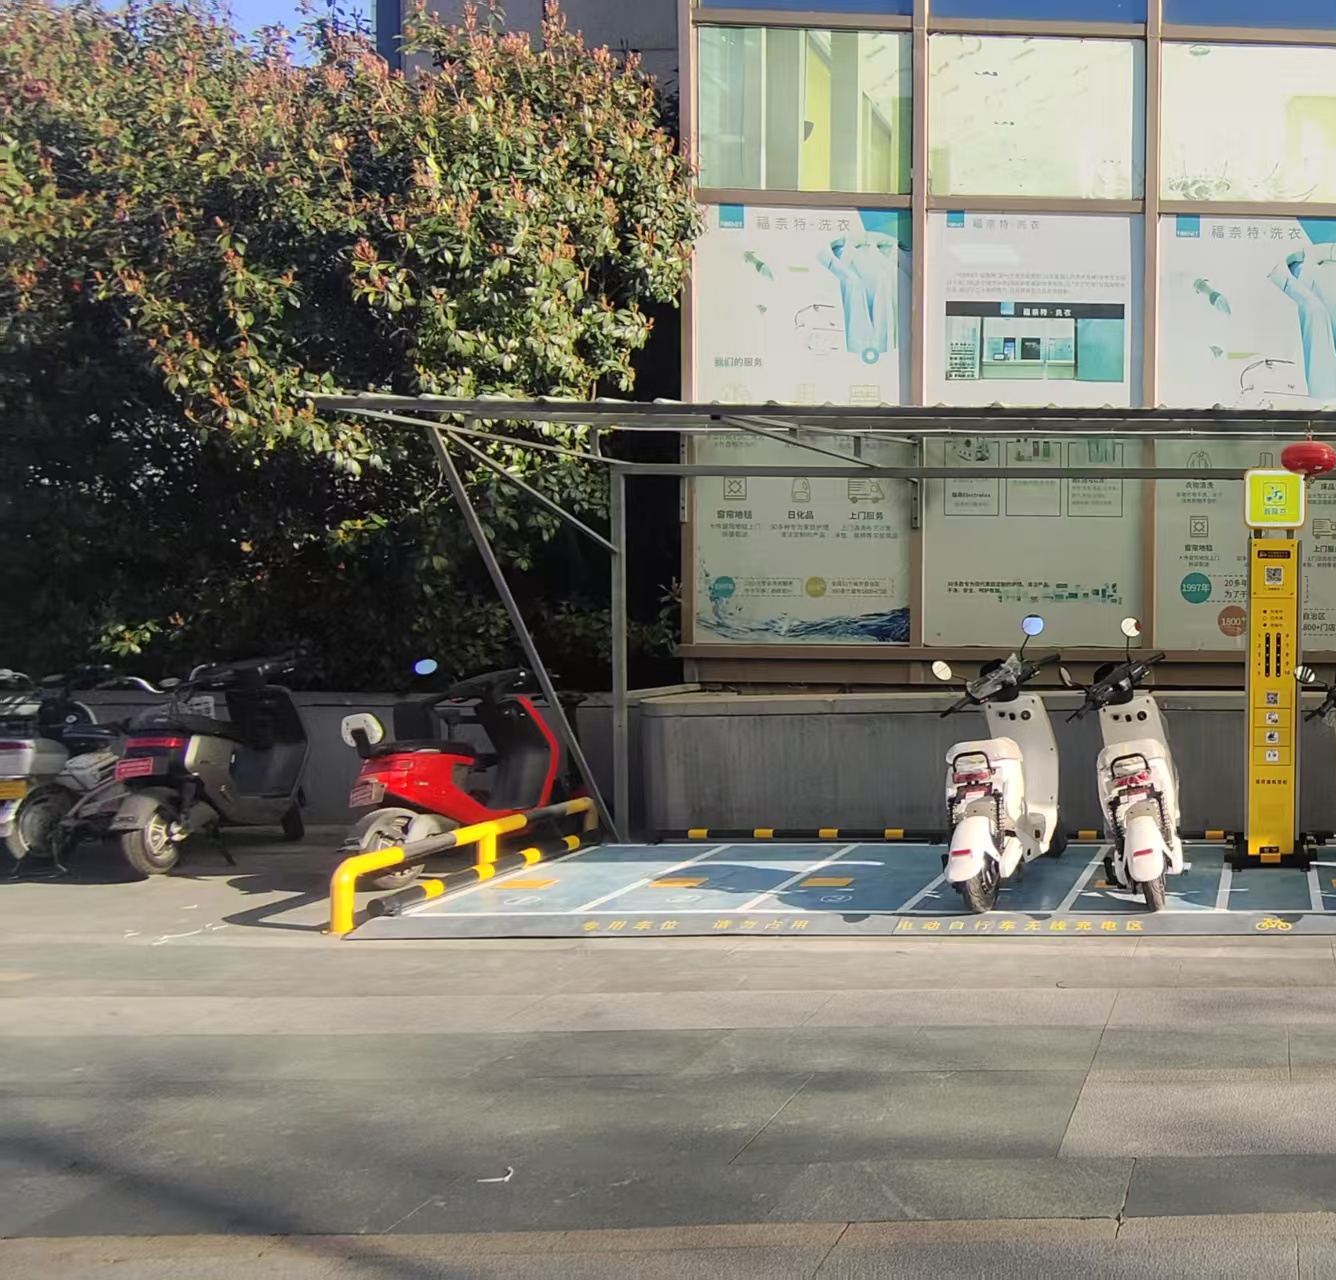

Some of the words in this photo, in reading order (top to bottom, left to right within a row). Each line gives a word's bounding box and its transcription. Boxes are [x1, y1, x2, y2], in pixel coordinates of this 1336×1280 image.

[714, 357, 763, 368] 我们的服务
[716, 510, 753, 520] 窗帘地毯
[787, 510, 814, 520] 日化品
[849, 511, 884, 520] 上门服务
[1184, 544, 1213, 552] 窗帘地毯
[1181, 583, 1210, 593] 1997年
[583, 920, 681, 931] 专用车位
[712, 919, 809, 930] 请勿占用
[897, 919, 1145, 931] 电动自行车无线充电区
